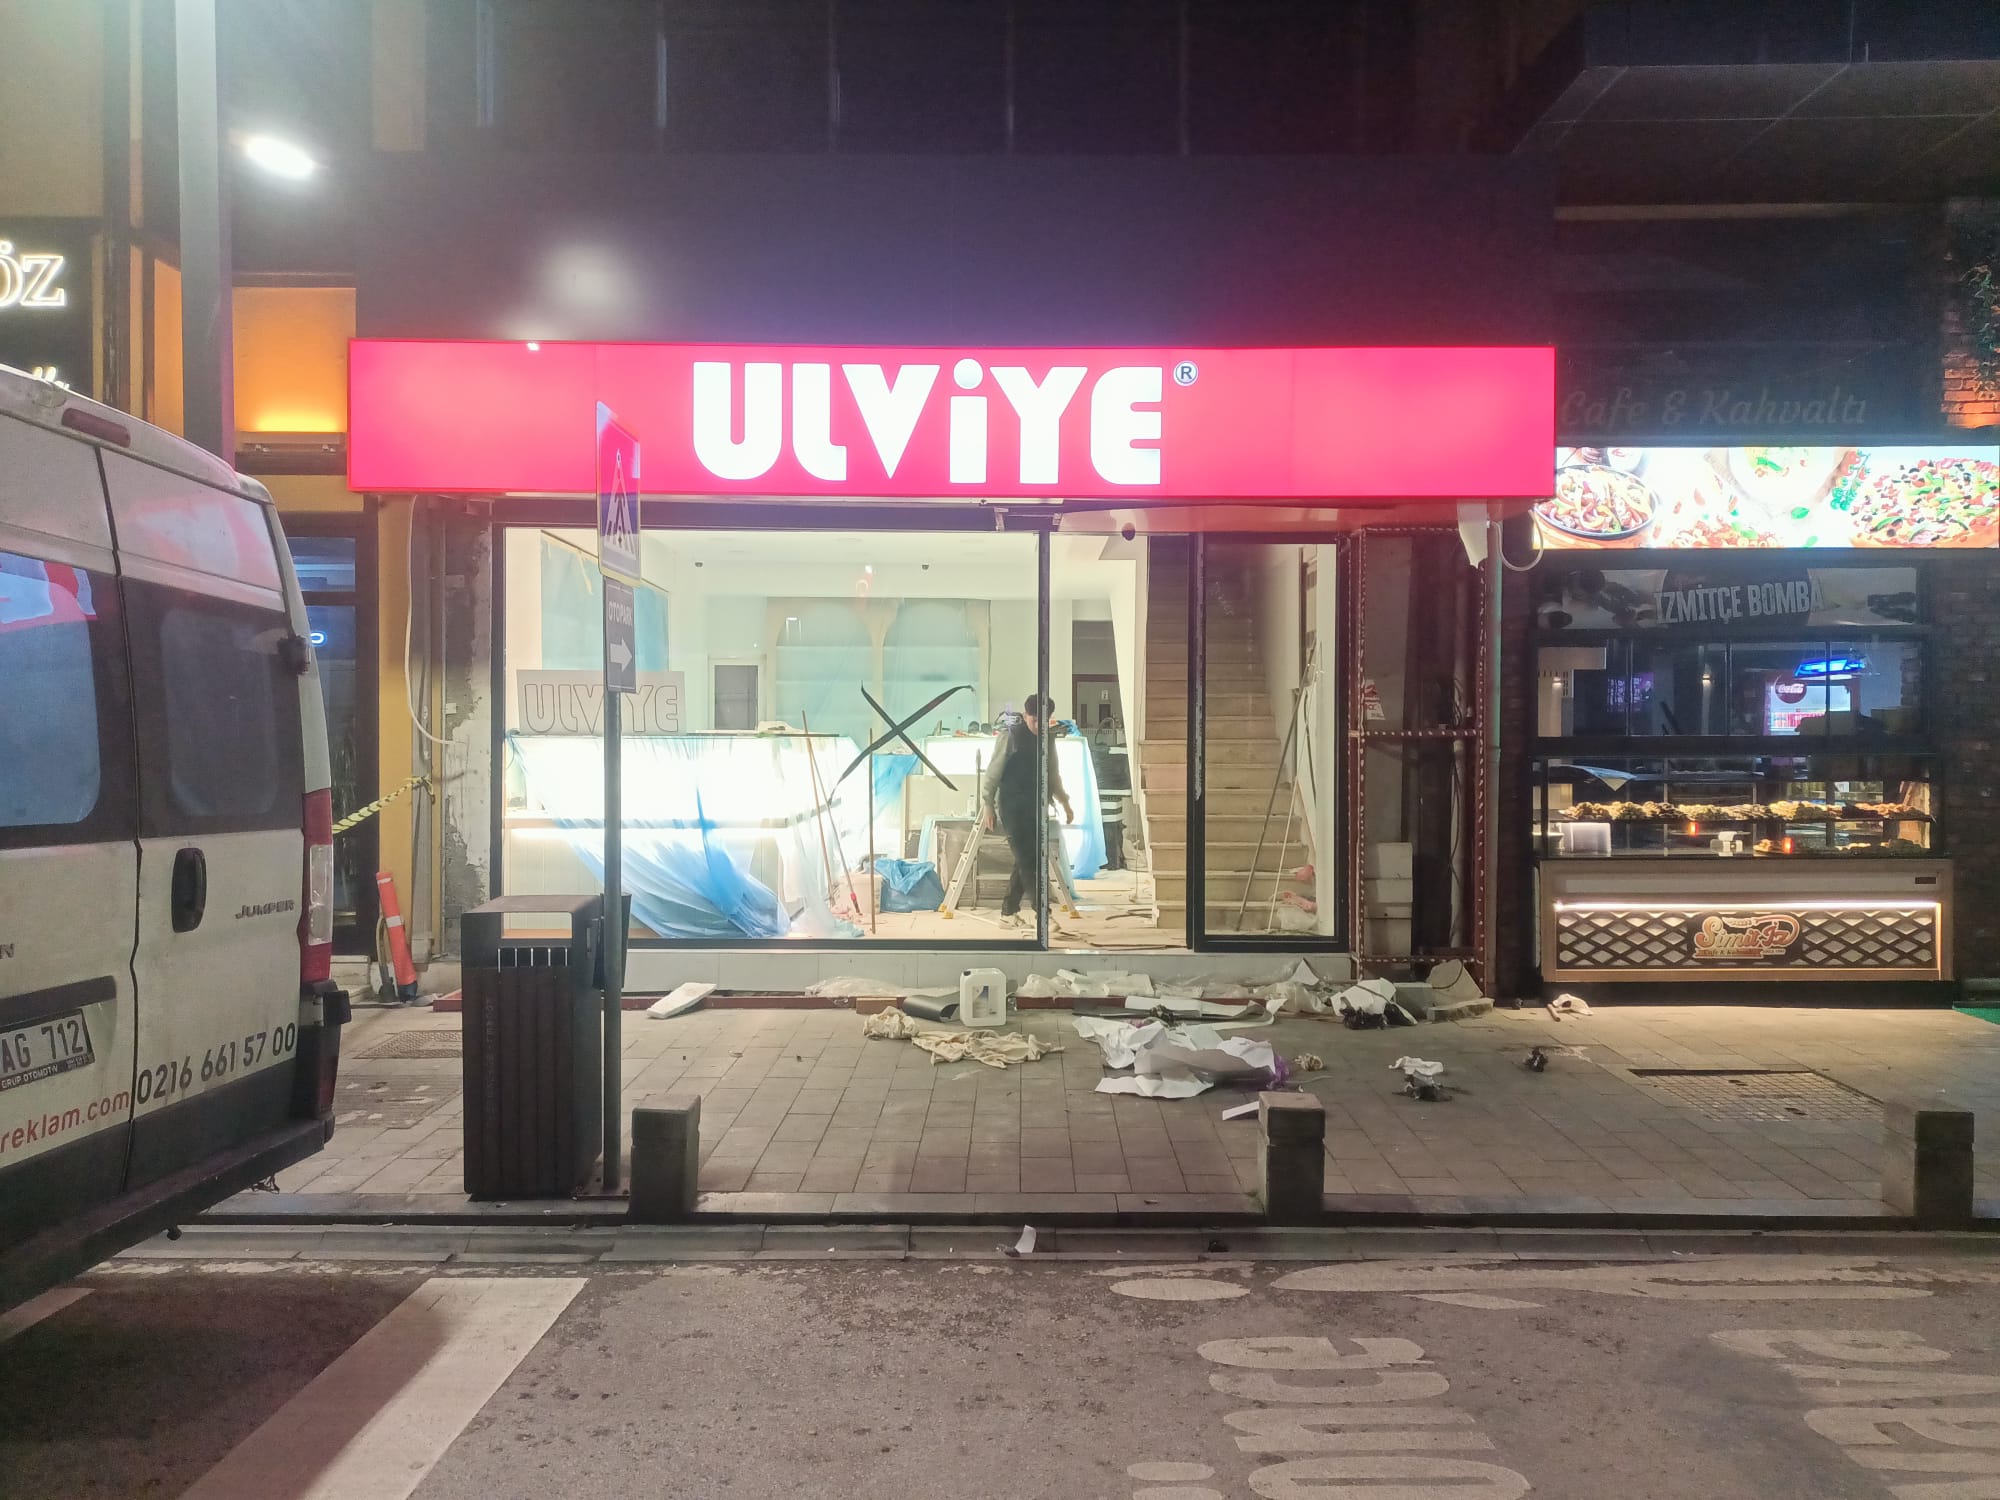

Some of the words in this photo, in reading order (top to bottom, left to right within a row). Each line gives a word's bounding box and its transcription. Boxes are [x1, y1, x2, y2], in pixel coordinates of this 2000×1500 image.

[1562, 386, 1646, 429] Cafe
[1747, 577, 1825, 616] BOMBA
[523, 683, 680, 734] ULVYE
[234, 899, 295, 919] JUMPER
[2, 1032, 31, 1075] AG
[41, 1019, 85, 1060] 712
[137, 1056, 193, 1105] 0216
[201, 1043, 236, 1081] 661
[243, 1031, 267, 1067] 57
[272, 1022, 296, 1056] 00
